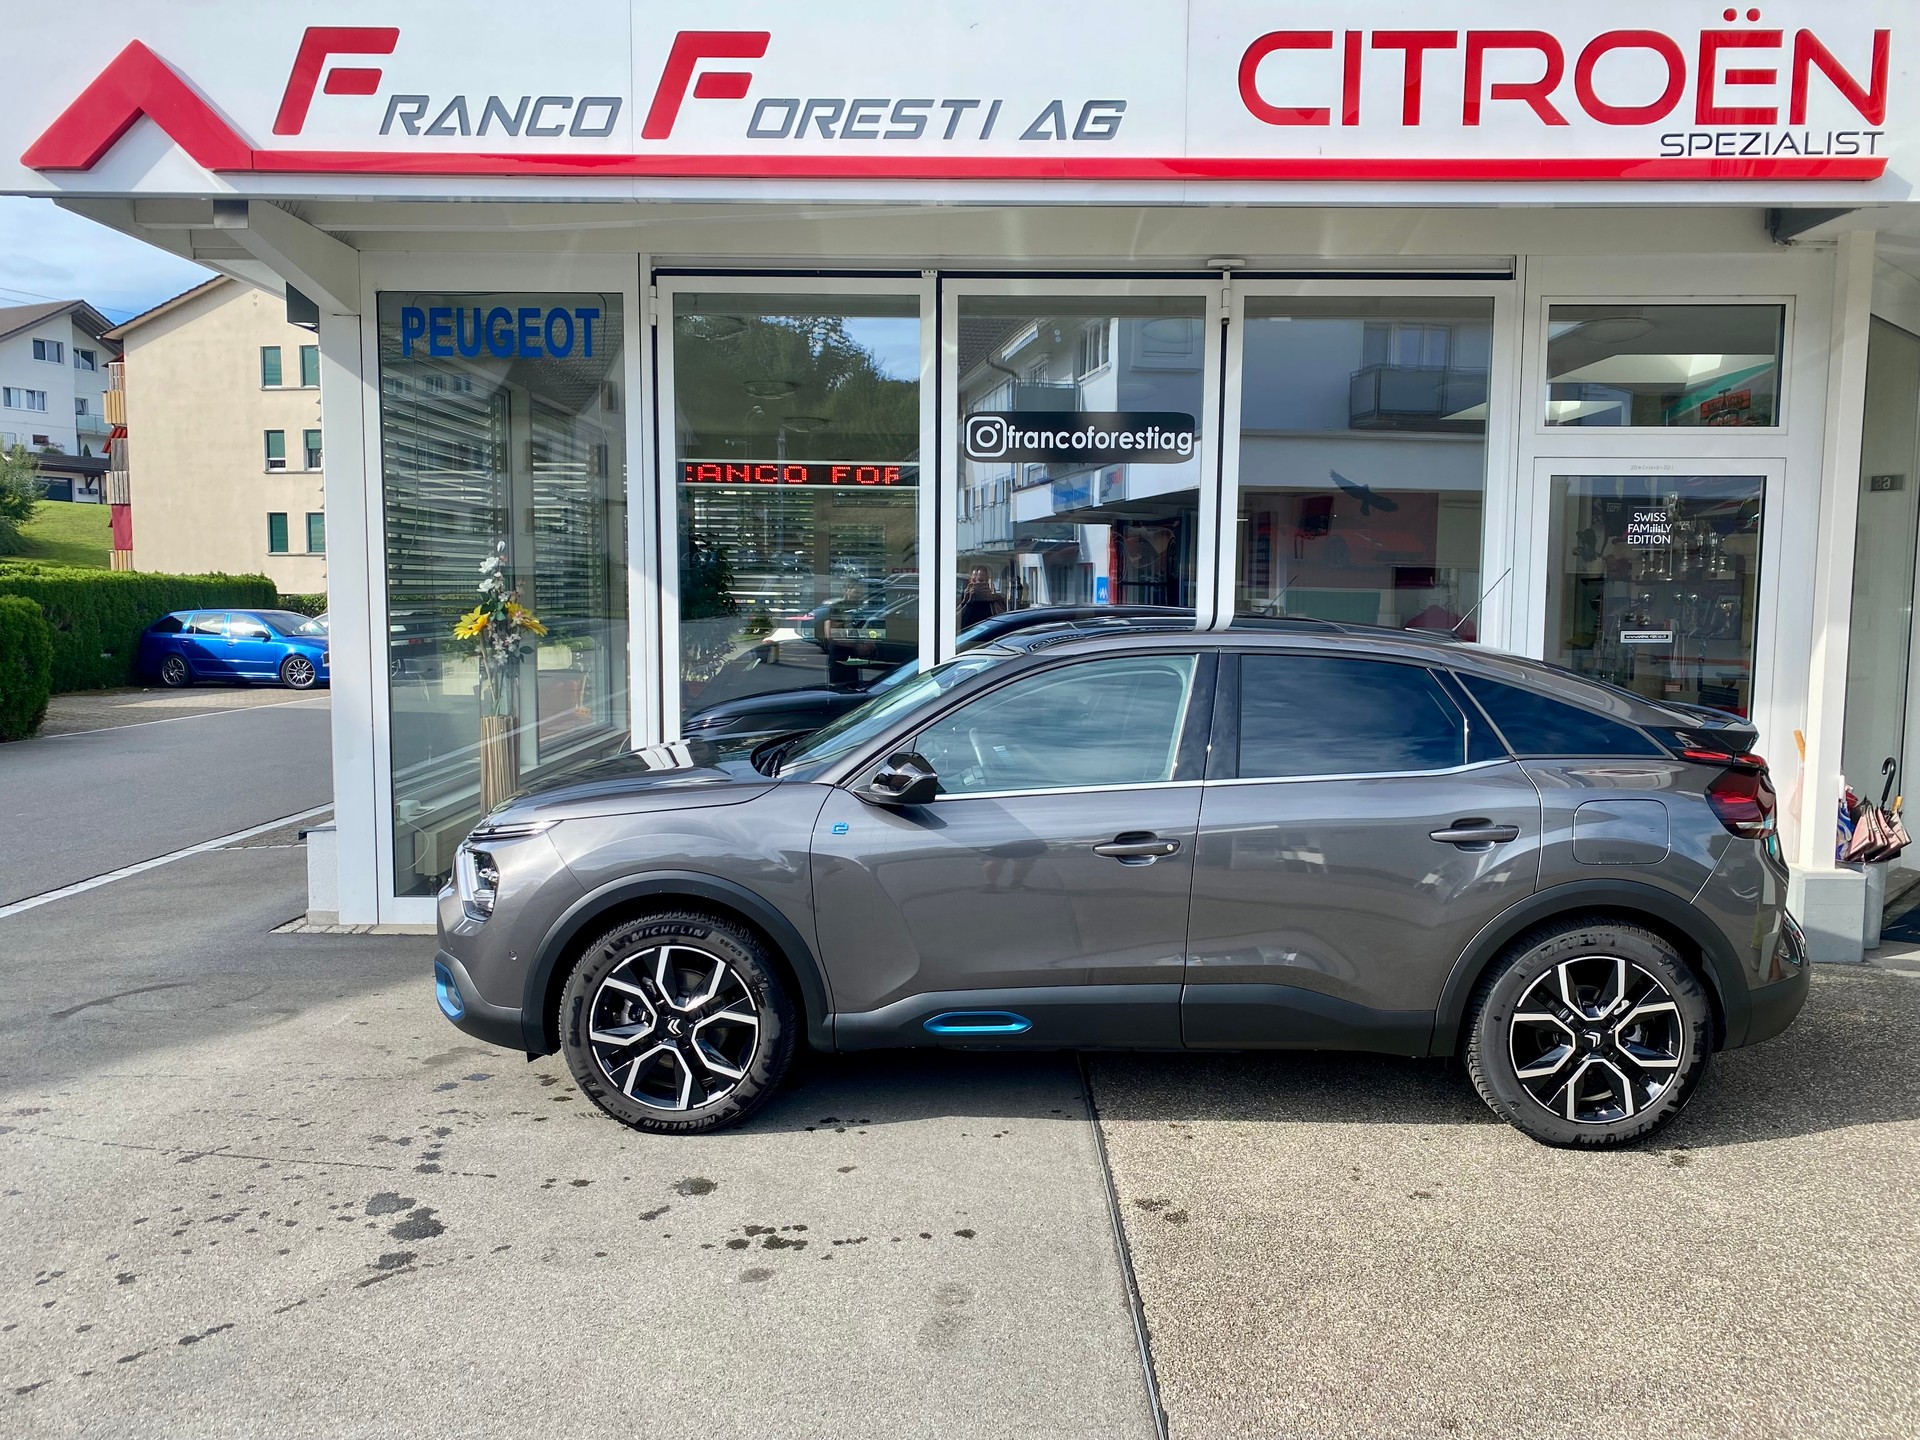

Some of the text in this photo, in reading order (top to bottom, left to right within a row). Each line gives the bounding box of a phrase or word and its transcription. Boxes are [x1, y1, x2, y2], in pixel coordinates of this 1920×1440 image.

[1238, 8, 1891, 126] CITROËN
[272, 26, 1127, 141] FRANCO FORESTI AG
[1660, 131, 1884, 157] SPEZIALIST
[402, 307, 600, 358] PEUGEOT
[1008, 426, 1193, 456] francoforestiag
[1633, 512, 1667, 522] SWISS
[1627, 535, 1671, 545] EDITION
[631, 925, 705, 942] MICHELIN
